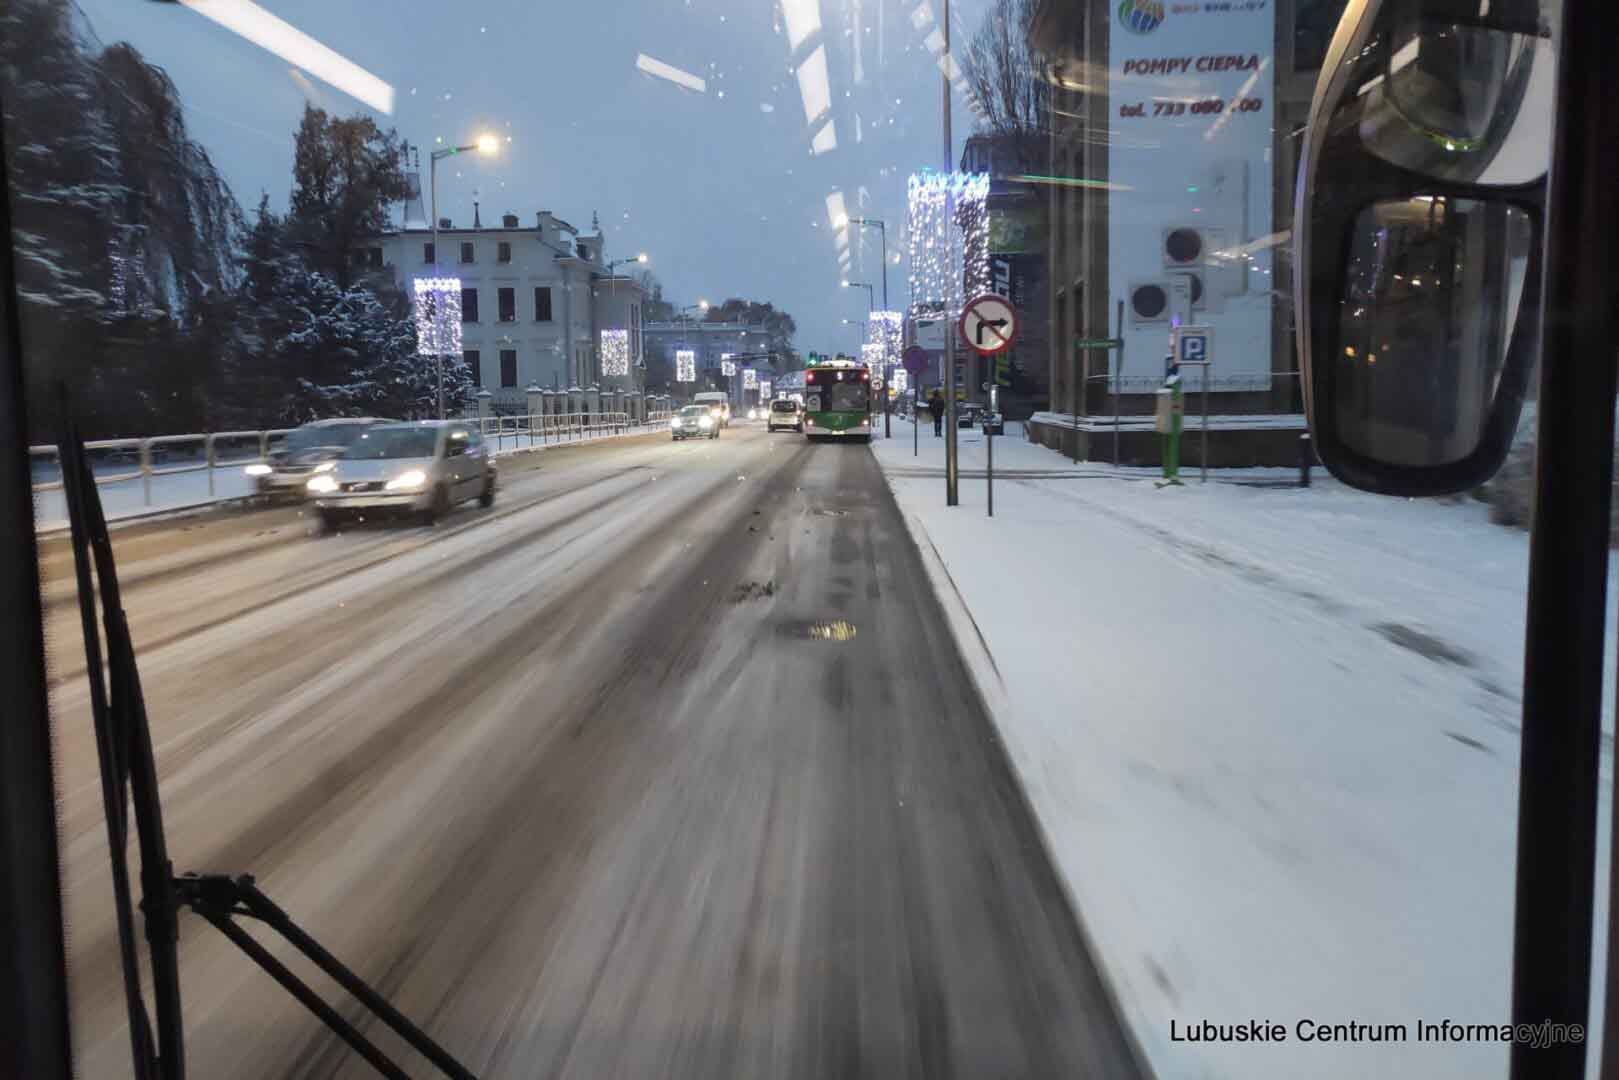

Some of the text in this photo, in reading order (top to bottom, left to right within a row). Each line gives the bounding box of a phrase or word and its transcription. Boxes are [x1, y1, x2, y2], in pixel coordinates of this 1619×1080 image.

[1124, 54, 1259, 75] POMPY CIEPŁA
[1185, 338, 1201, 359] P
